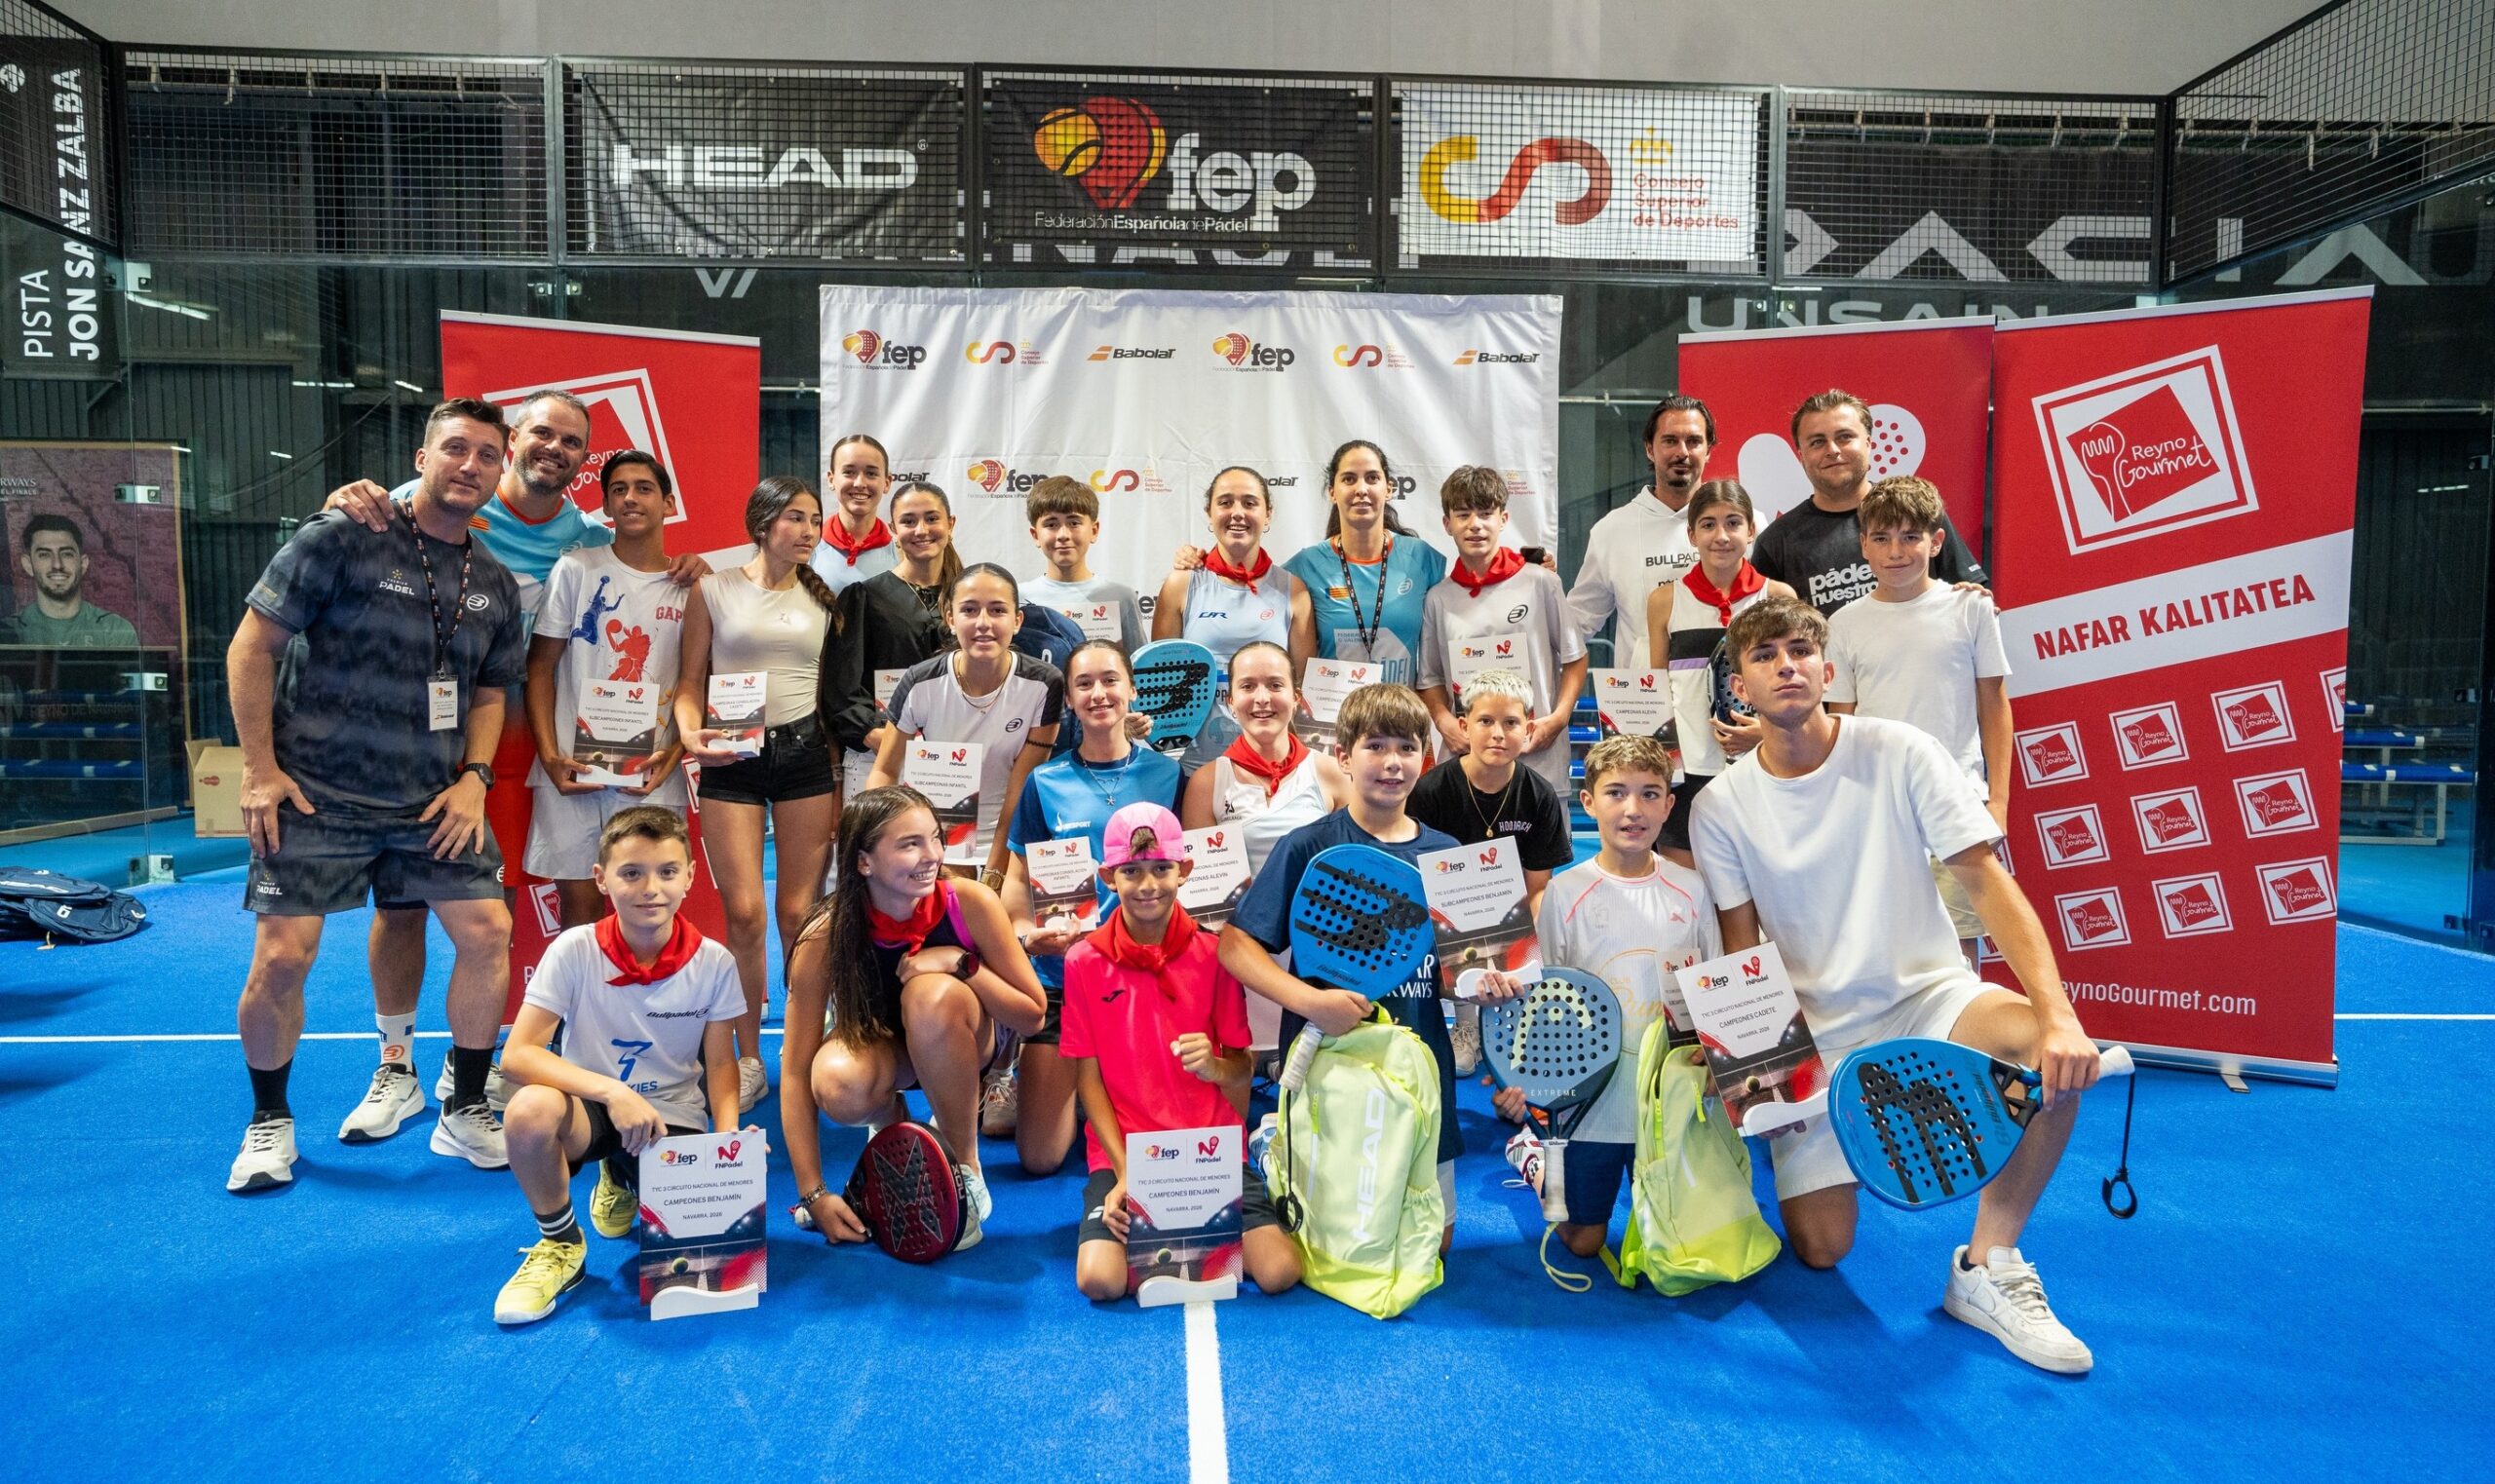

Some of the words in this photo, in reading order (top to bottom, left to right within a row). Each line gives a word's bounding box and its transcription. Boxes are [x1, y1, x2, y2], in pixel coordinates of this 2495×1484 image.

[51, 67, 88, 179] ZALBA
[613, 144, 919, 188] HEAD
[1167, 133, 1317, 232] fep
[1633, 173, 1705, 190] Consejo
[1634, 193, 1709, 211] Superior
[1633, 213, 1653, 227] de
[1660, 212, 1739, 230] Deportes
[59, 188, 96, 279] SANZ
[19, 269, 53, 358] PISTA
[66, 288, 99, 361] JON
[882, 341, 927, 369] fep
[1250, 343, 1294, 372] fep
[2131, 438, 2186, 461] Reyno
[2119, 436, 2211, 488] Gourmet
[1389, 476, 1417, 500] ep
[379, 581, 415, 595] PADEL
[655, 606, 683, 624] GAP
[2033, 614, 2131, 661] NAFAR
[2138, 574, 2316, 636] KALITATEA
[1473, 649, 1484, 658] fep
[1326, 668, 1339, 677] fep
[1616, 679, 1629, 688] fep
[2244, 711, 2280, 729] Gourmet
[2248, 711, 2270, 720] Reyno
[2141, 732, 2174, 748] Gourmet
[2145, 732, 2167, 741] Reyno
[927, 751, 940, 760] fep
[2043, 750, 2077, 766] Gourmet
[2047, 750, 2067, 759] Reyno
[2267, 799, 2302, 816] Gourmet
[2272, 799, 2293, 808] Reyno
[2163, 816, 2196, 832] Gourmet
[2166, 816, 2187, 825] Reyno
[2064, 832, 2095, 848] Gourmet
[2067, 832, 2088, 841] Reyno
[1184, 844, 1193, 853] ep
[1449, 860, 1466, 872] fep
[256, 885, 283, 895] PADEL
[2289, 887, 2325, 902] Gourmet
[2293, 887, 2317, 895] Reyno
[1440, 894, 1484, 908] SUBCAMPEONES
[2184, 901, 2217, 917] Gourmet
[2188, 900, 2209, 909] Reyno
[2085, 915, 2117, 931] Gourmet
[2089, 914, 2109, 923] Reyno
[1711, 974, 1729, 988] fep
[1387, 981, 1433, 999] WAYS
[2061, 980, 2257, 1016] eynoGourmet.com
[1713, 1005, 1734, 1015] CIRCUITO
[1734, 999, 1755, 1009] NACIONAL
[1763, 990, 1785, 1001] MENORES
[646, 1009, 697, 1020] Bullpadel
[1718, 1011, 1754, 1029] CAMPEONES
[1753, 1006, 1777, 1019] CADETE
[1530, 1088, 1577, 1097] EXTREME
[676, 1153, 698, 1166] fep
[1162, 1148, 1179, 1161] fep
[1351, 1086, 1386, 1241] HEAD
[667, 1184, 692, 1193] CIRCUITO
[728, 1179, 753, 1188] MENORES
[1148, 1190, 1187, 1199] CAMPEONES
[1188, 1187, 1220, 1197] BENJAMÍN
[664, 1196, 707, 1207] CAMPEONES
[707, 1193, 742, 1203] BENJAMÍN
